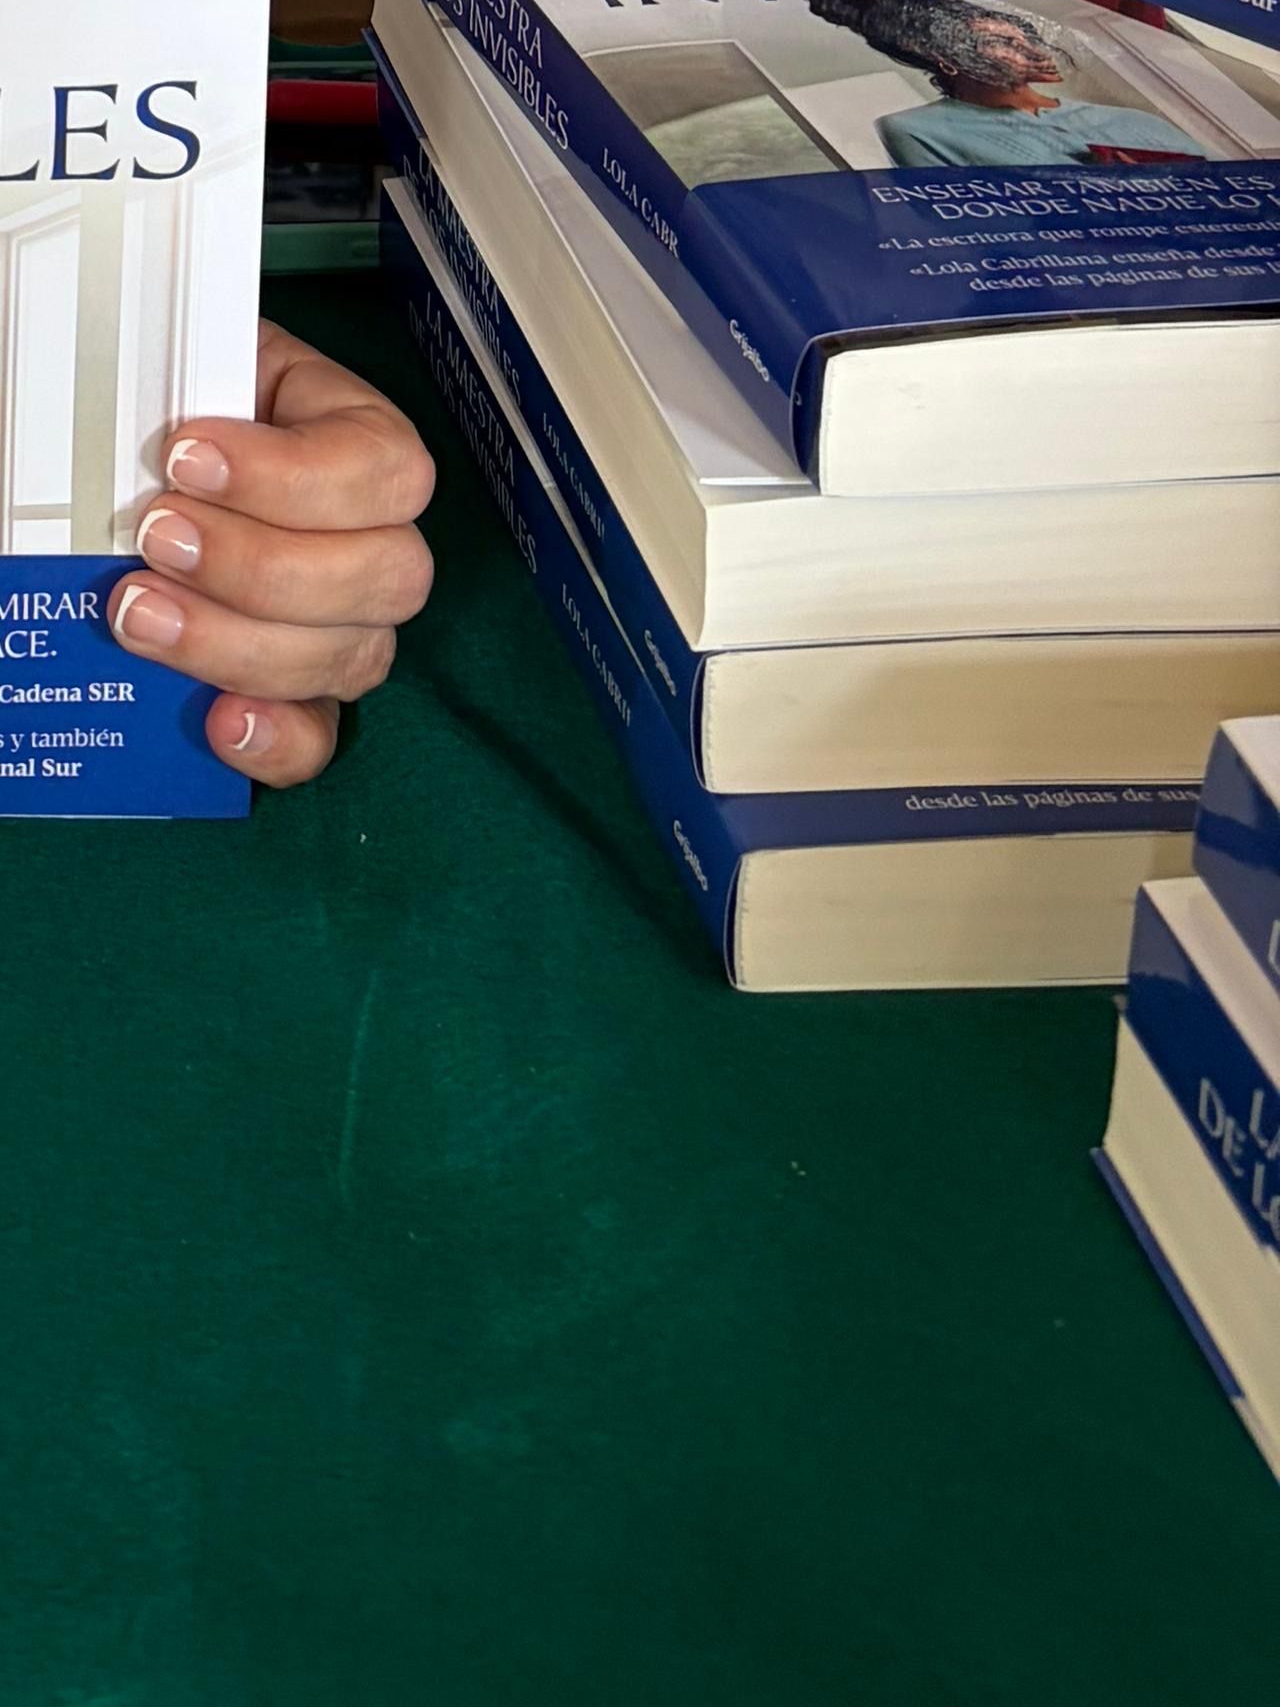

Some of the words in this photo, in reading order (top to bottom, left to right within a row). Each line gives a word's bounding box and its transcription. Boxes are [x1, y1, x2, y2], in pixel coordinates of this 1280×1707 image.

[469, 1, 571, 151] INVISIBLES
[602, 147, 639, 208] LOLA
[88, 682, 135, 702] SER
[10, 733, 25, 753] y
[31, 728, 124, 748] también
[41, 758, 83, 777] Sur
